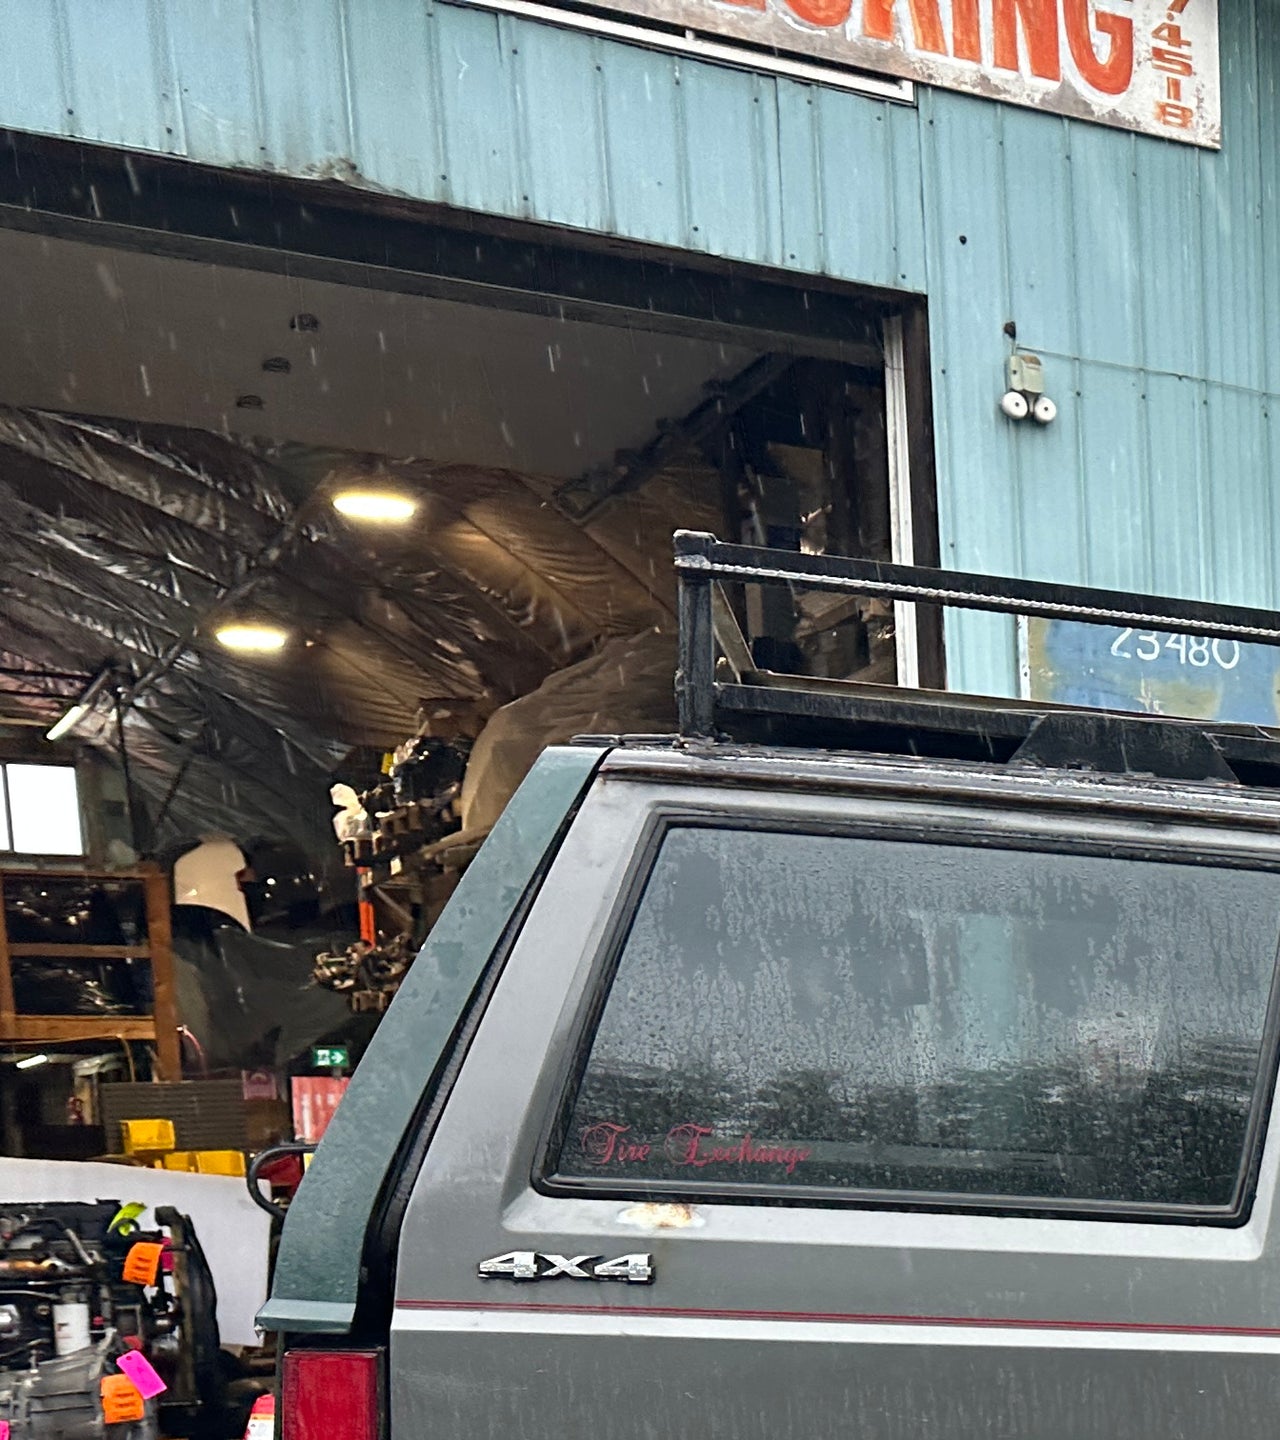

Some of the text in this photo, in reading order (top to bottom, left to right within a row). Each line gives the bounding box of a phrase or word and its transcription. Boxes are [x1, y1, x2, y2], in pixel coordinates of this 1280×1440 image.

[1110, 626, 1240, 670] 23480
[579, 1121, 813, 1174] Tire Exchange
